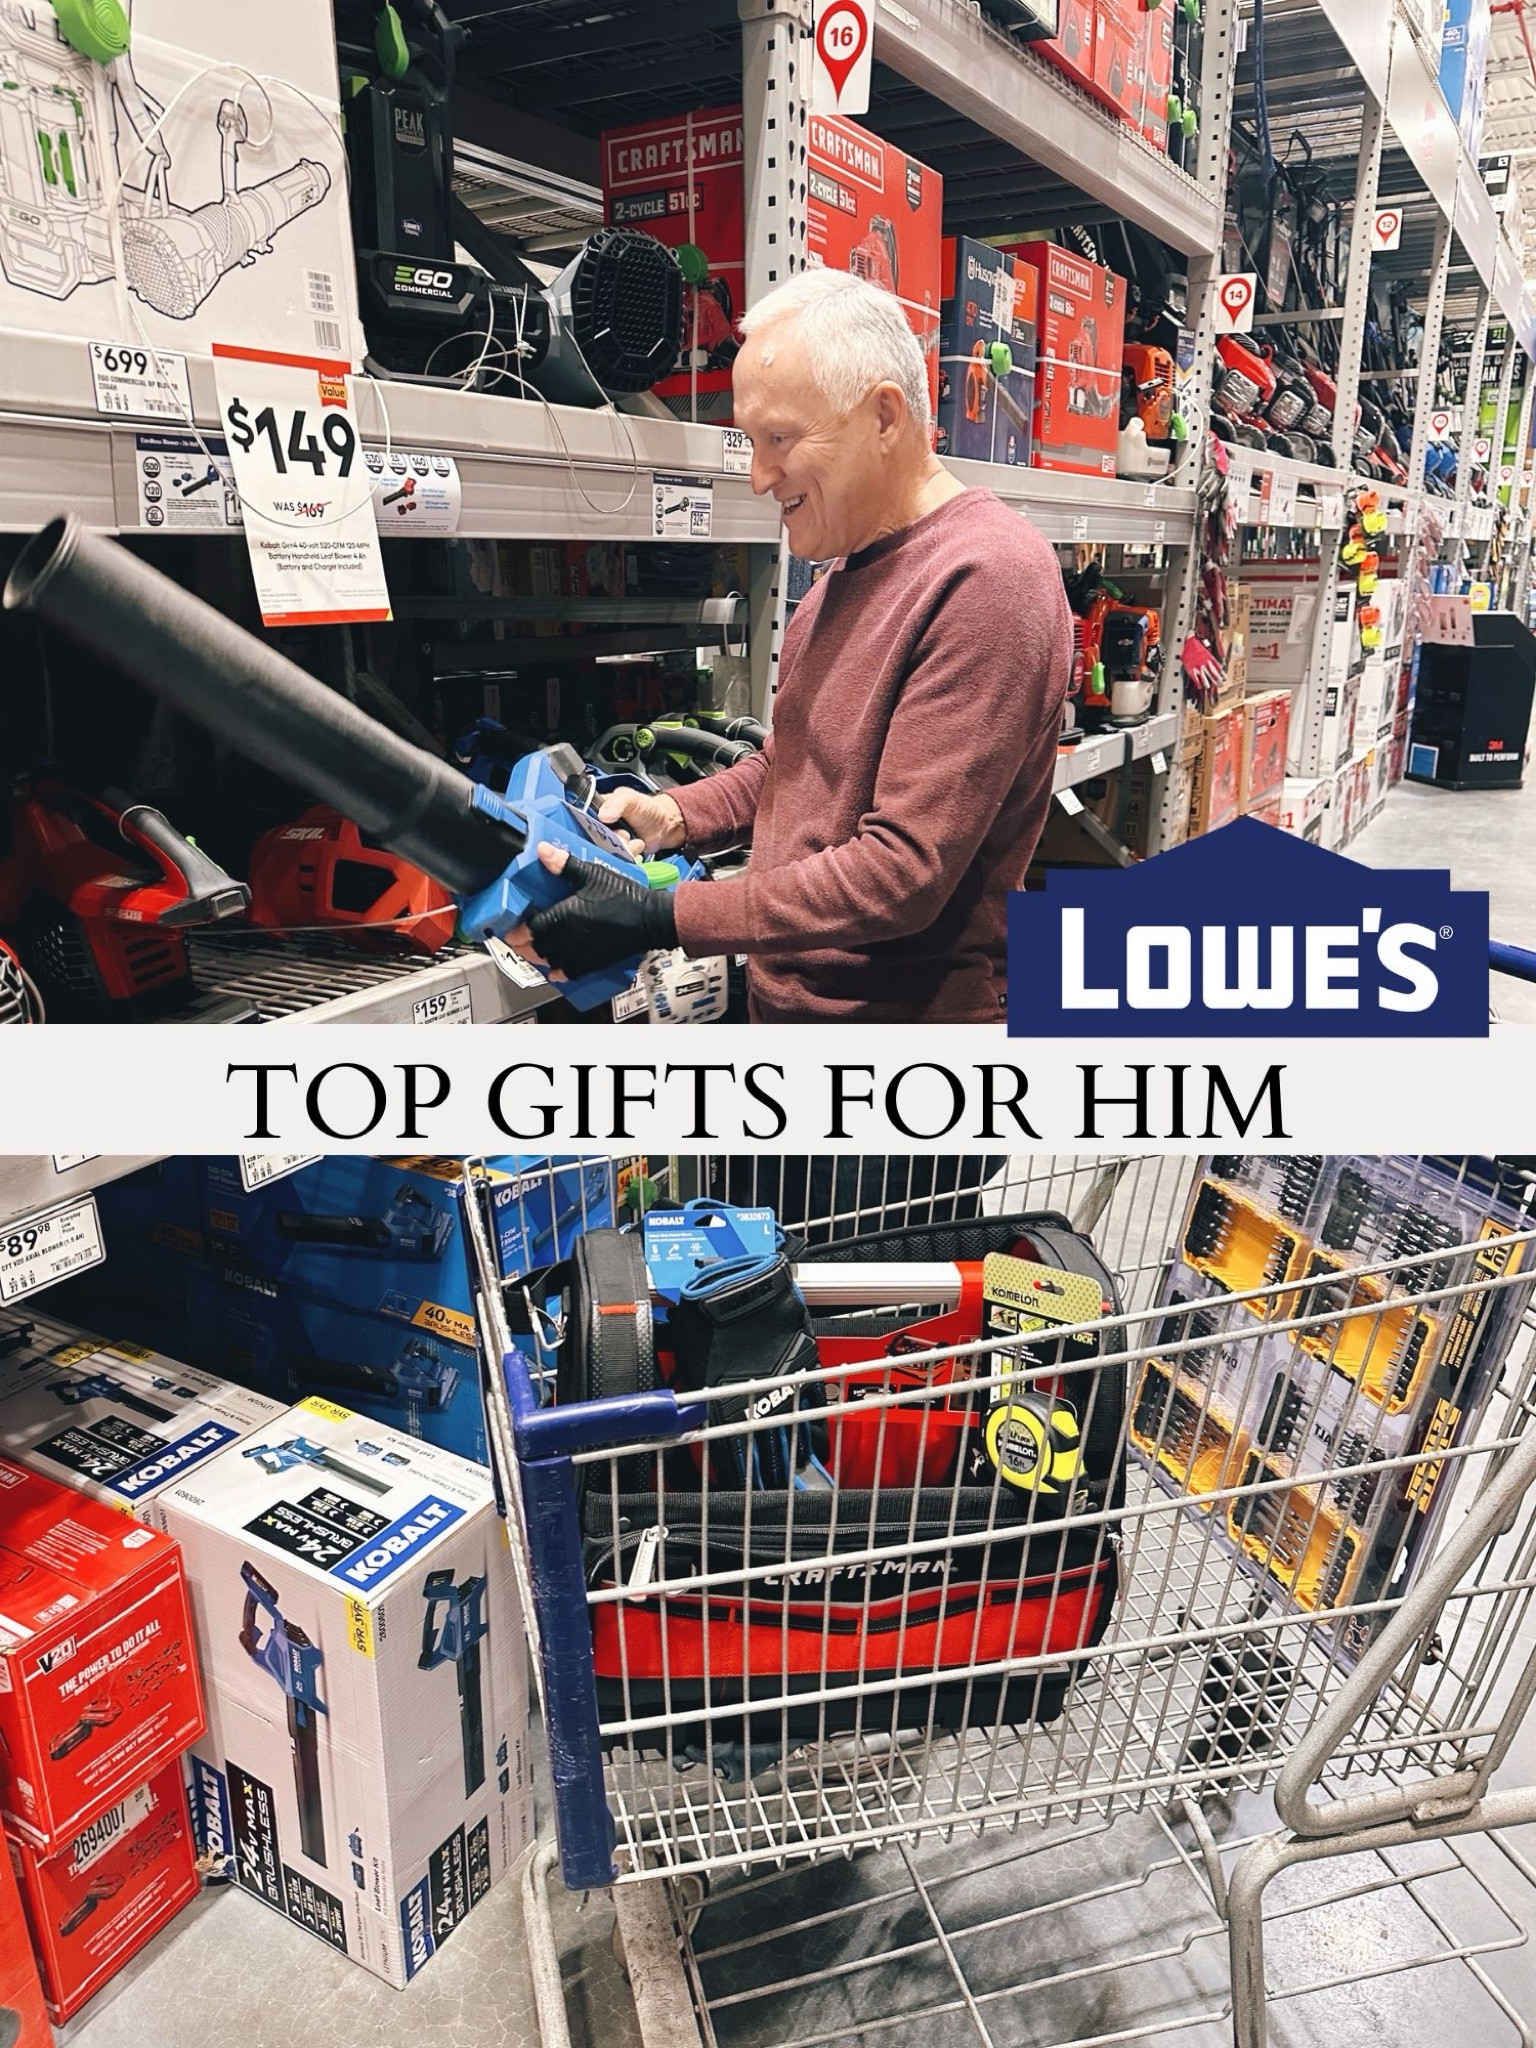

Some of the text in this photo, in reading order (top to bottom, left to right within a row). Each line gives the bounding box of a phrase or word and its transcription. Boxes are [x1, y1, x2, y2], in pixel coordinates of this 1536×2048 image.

[830, 25, 854, 48] 16
[394, 107, 424, 132] PEAK
[811, 121, 880, 179] CRAFTSMAN
[810, 174, 838, 206] 2-CYCLE
[615, 199, 666, 220] 2-CYCLE
[1381, 219, 1393, 230] 12
[394, 265, 453, 288] EGO
[1052, 260, 1090, 291] CRAFTSMAN
[394, 284, 453, 298] COMMERCIAL
[1229, 289, 1243, 301] 14
[94, 346, 147, 375] $699
[321, 374, 343, 384] Special
[321, 386, 345, 398] Value
[228, 397, 355, 477] $149
[413, 457, 426, 466] 140
[147, 486, 159, 495] 120
[273, 502, 294, 512] WAS
[268, 552, 290, 561] Battery
[292, 552, 320, 560] Handheld
[302, 563, 313, 571] and
[314, 563, 337, 572] Charger
[1488, 740, 1503, 750] 3M
[281, 827, 325, 840] SKIL
[415, 995, 447, 1018] $159
[60, 1212, 81, 1223] Everyday
[649, 1216, 684, 1226] KOBALT
[764, 1225, 770, 1234] L
[2, 1263, 13, 1272] CFT
[26, 1252, 40, 1262] AXIAL
[41, 1242, 63, 1255] BLOWER
[223, 1267, 278, 1298] KOBALT
[992, 1286, 1040, 1307] KOMELON
[1073, 1333, 1094, 1346] LOCK
[63, 1431, 132, 1465] BRUSHLESS
[117, 1426, 225, 1493] KOBALT
[262, 1515, 297, 1537] MAX
[274, 1507, 353, 1549] BRUSHLESS
[346, 1503, 450, 1582] KOBALT
[764, 1560, 953, 1587] CRAFTSMAN
[38, 1642, 73, 1673] V20
[58, 1621, 161, 1697] THE POWER TO DO IT ALL
[202, 1766, 224, 1854] OBALT
[243, 1780, 257, 1830] MAX
[73, 1802, 126, 1865] 2694007
[257, 1788, 278, 1901] BRUSHLESS
[452, 1833, 464, 1918] BRUSHLESS
[408, 1888, 428, 1970] KOBALT
